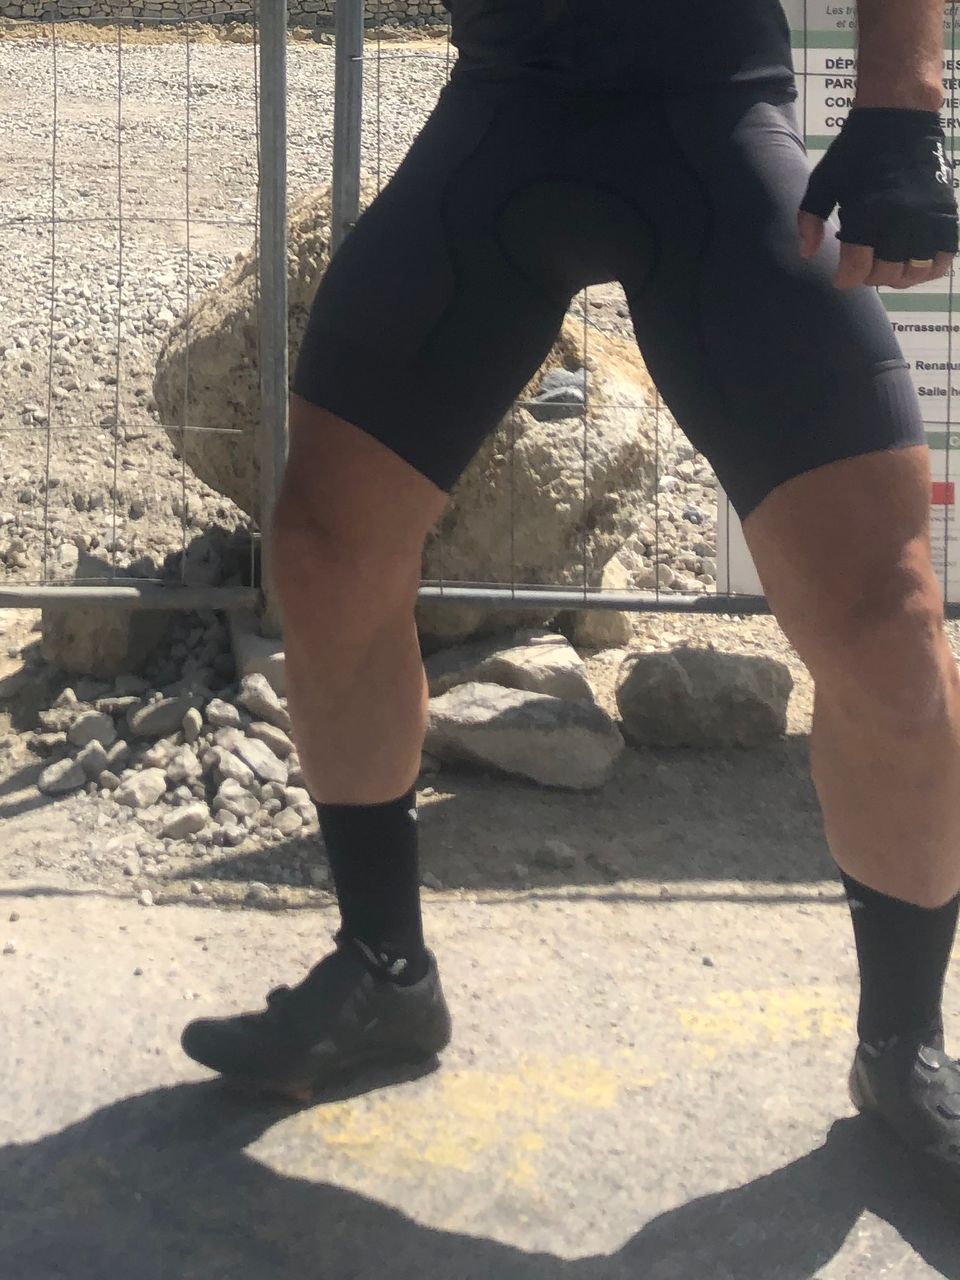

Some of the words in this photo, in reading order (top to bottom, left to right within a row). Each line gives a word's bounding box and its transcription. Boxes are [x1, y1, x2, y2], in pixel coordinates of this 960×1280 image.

[826, 5, 844, 16] Les
[825, 57, 856, 70] DÉP
[918, 387, 947, 397] Salle
